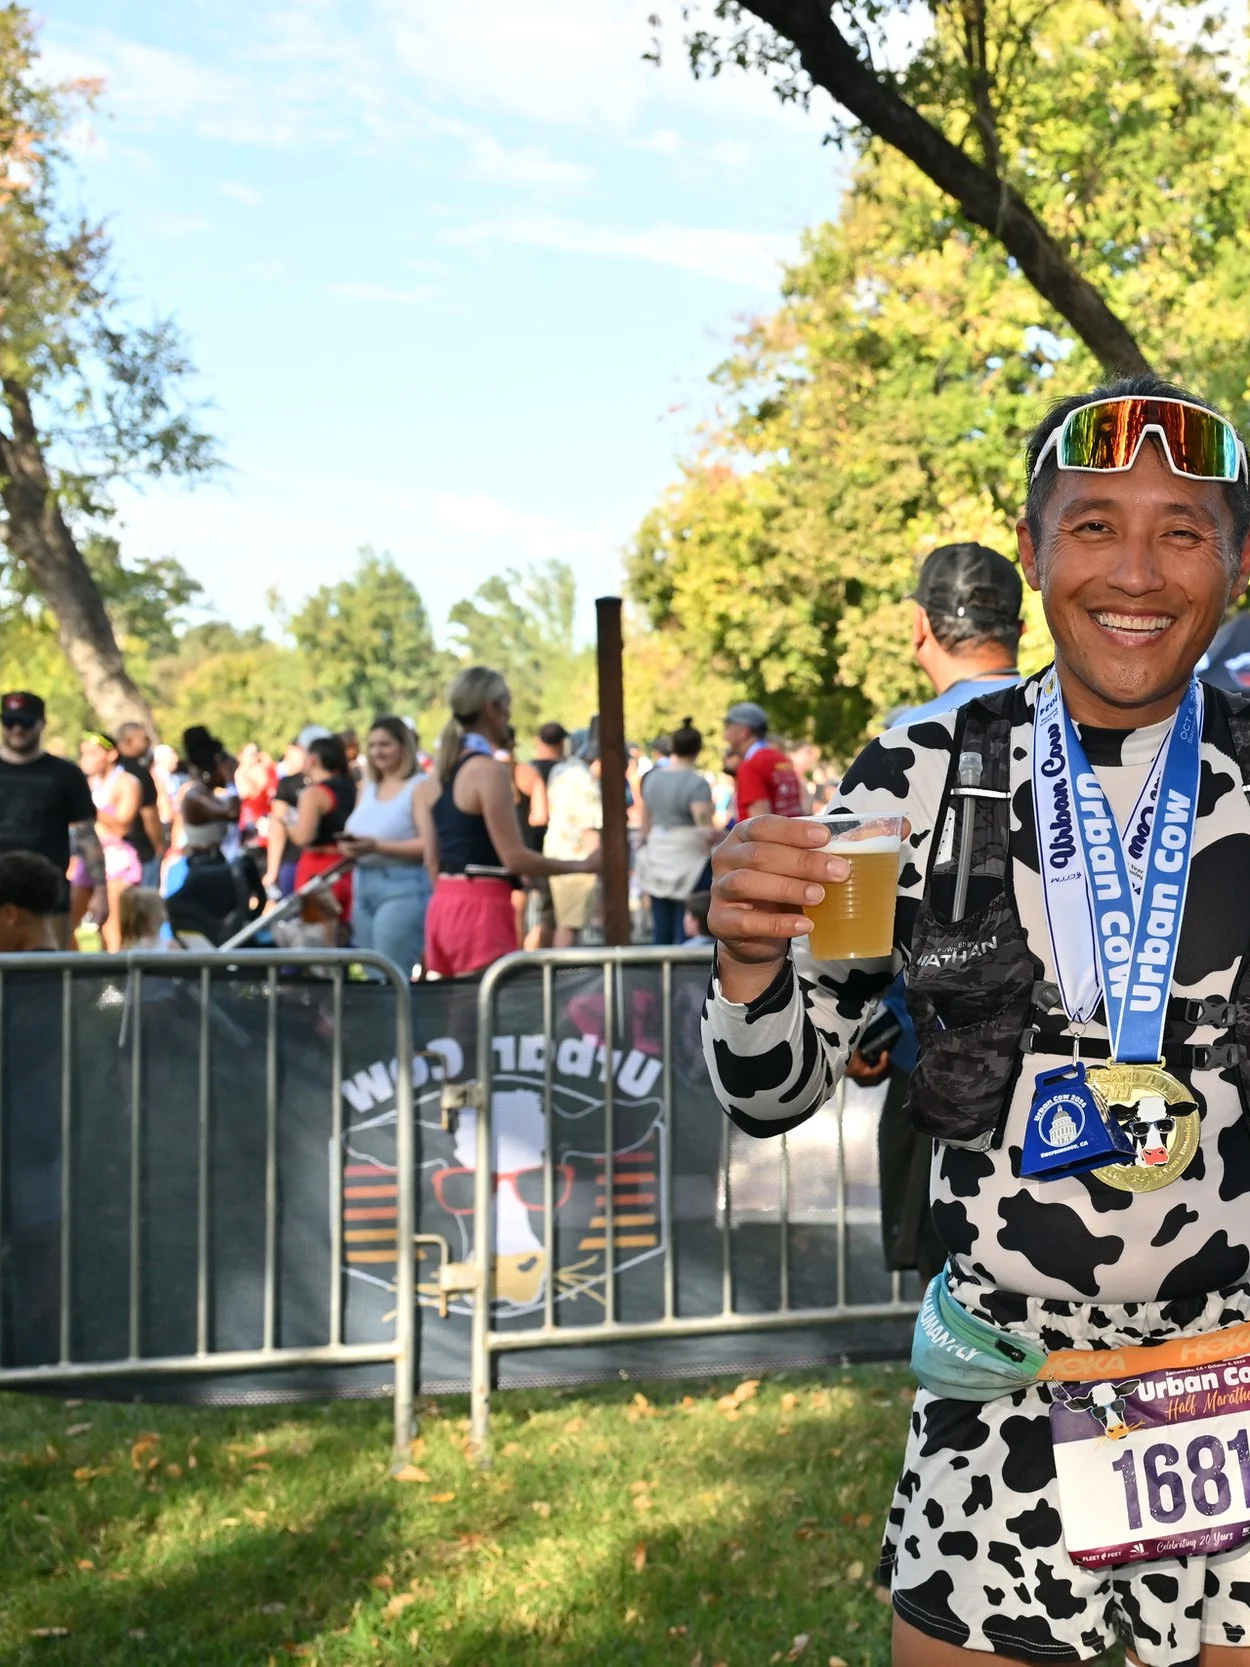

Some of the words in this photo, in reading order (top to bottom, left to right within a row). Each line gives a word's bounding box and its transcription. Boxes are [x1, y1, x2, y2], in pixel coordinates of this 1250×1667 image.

[1181, 717, 1193, 741] OCT
[1041, 723, 1066, 777] Cow
[1049, 778, 1077, 869] Urban
[1154, 788, 1192, 874] Cow
[1076, 773, 1122, 900] Urban
[1101, 916, 1133, 998] Cow
[1129, 882, 1180, 1013] Urban
[1033, 1099, 1053, 1122] Urban
[1052, 1094, 1070, 1102] Cow
[1070, 1094, 1087, 1108] 2024
[1040, 1144, 1080, 1159] Sacramento,
[1137, 1373, 1219, 1402] Urban
[1165, 1393, 1197, 1421] Half
[1156, 1538, 1197, 1553] Celebrating
[1199, 1534, 1212, 1546] 20
[1213, 1530, 1233, 1546] Years
[1082, 1553, 1101, 1562] FLEET
[1107, 1551, 1122, 1559] FEET
